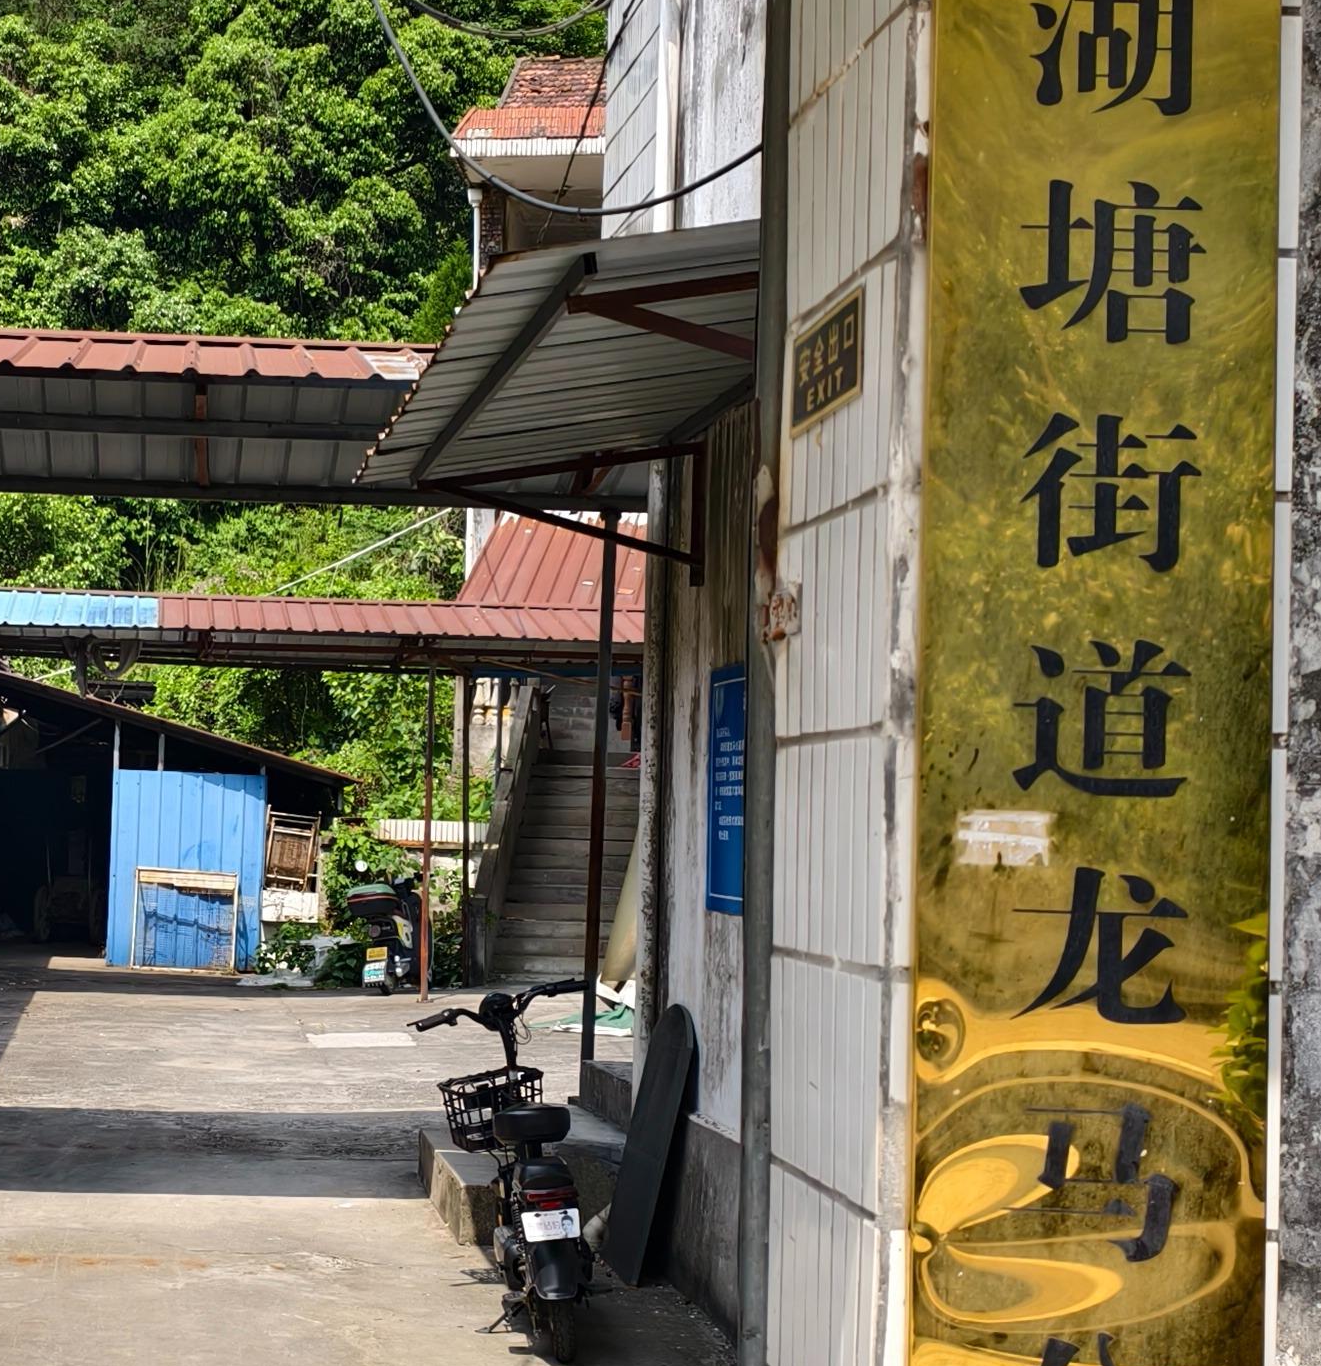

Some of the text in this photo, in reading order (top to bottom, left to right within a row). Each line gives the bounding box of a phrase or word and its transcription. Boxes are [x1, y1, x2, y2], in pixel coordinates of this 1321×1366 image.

[798, 313, 855, 388] 安全出口
[806, 365, 844, 412] EXIT
